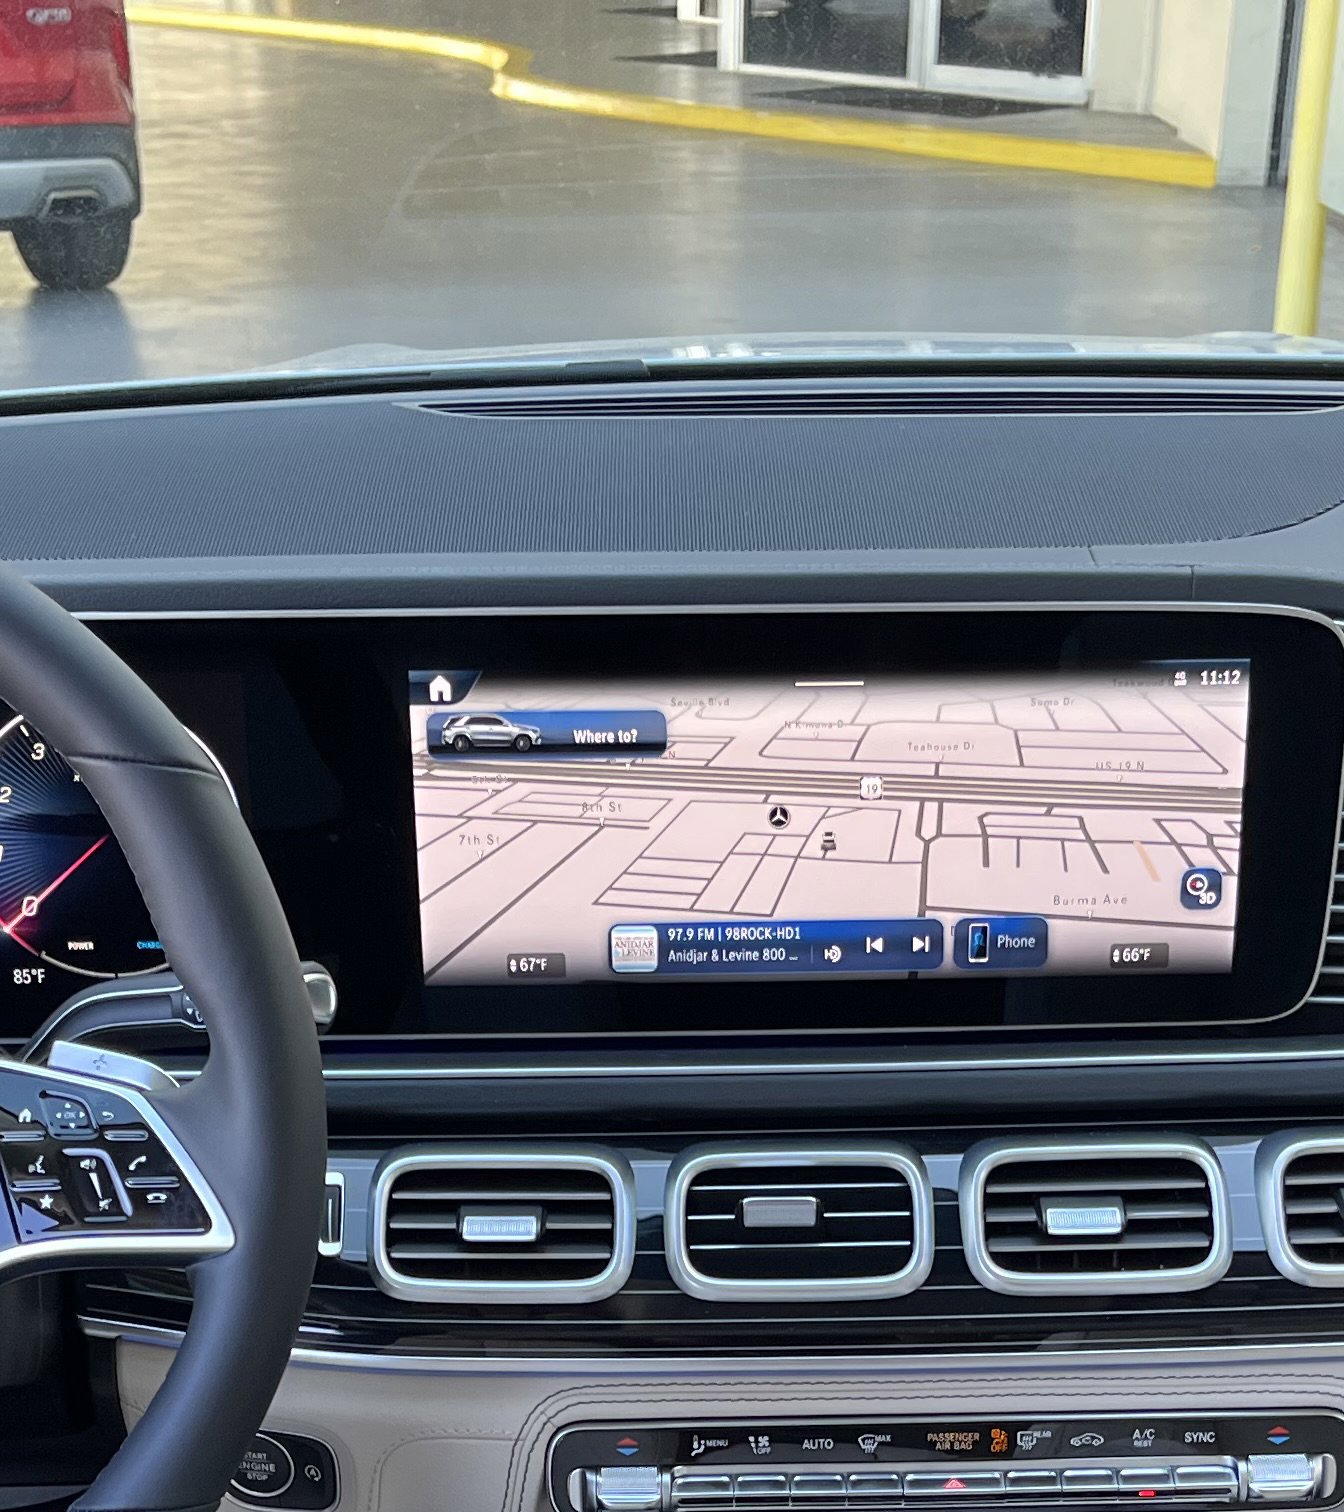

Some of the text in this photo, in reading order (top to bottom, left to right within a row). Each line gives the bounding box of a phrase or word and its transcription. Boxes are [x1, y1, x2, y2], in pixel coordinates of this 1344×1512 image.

[1200, 669, 1241, 686] 11:12
[572, 729, 638, 744] Where to?
[30, 742, 45, 761] 3
[907, 741, 959, 752] Teahouse
[1136, 760, 1145, 771] N
[865, 783, 879, 795] 19
[581, 801, 622, 813] 8th St
[459, 833, 501, 846] 7th St
[1053, 893, 1129, 906] Burma Ave
[1198, 892, 1217, 905] 3D
[21, 895, 40, 917] 0
[667, 927, 695, 941] 97.9
[697, 927, 715, 941] FM
[724, 926, 801, 941] 98ROCK-HD1
[67, 940, 94, 951] POWER
[997, 935, 1036, 949] Phone
[668, 947, 786, 965] Anidjar & Levine 800
[1122, 947, 1151, 962] 66°F
[519, 957, 548, 972] 67°F
[12, 968, 46, 985] 85°F
[63, 1110, 77, 1120] OK
[874, 1434, 892, 1444] MAX
[927, 1432, 981, 1443] PASSENGER
[1132, 1428, 1156, 1440] A/C
[1184, 1430, 1216, 1443] SYNC
[706, 1438, 729, 1448] MENU
[801, 1439, 835, 1451] AUTO
[934, 1441, 974, 1451] AIR BAG
[246, 1472, 269, 1481] STOP
